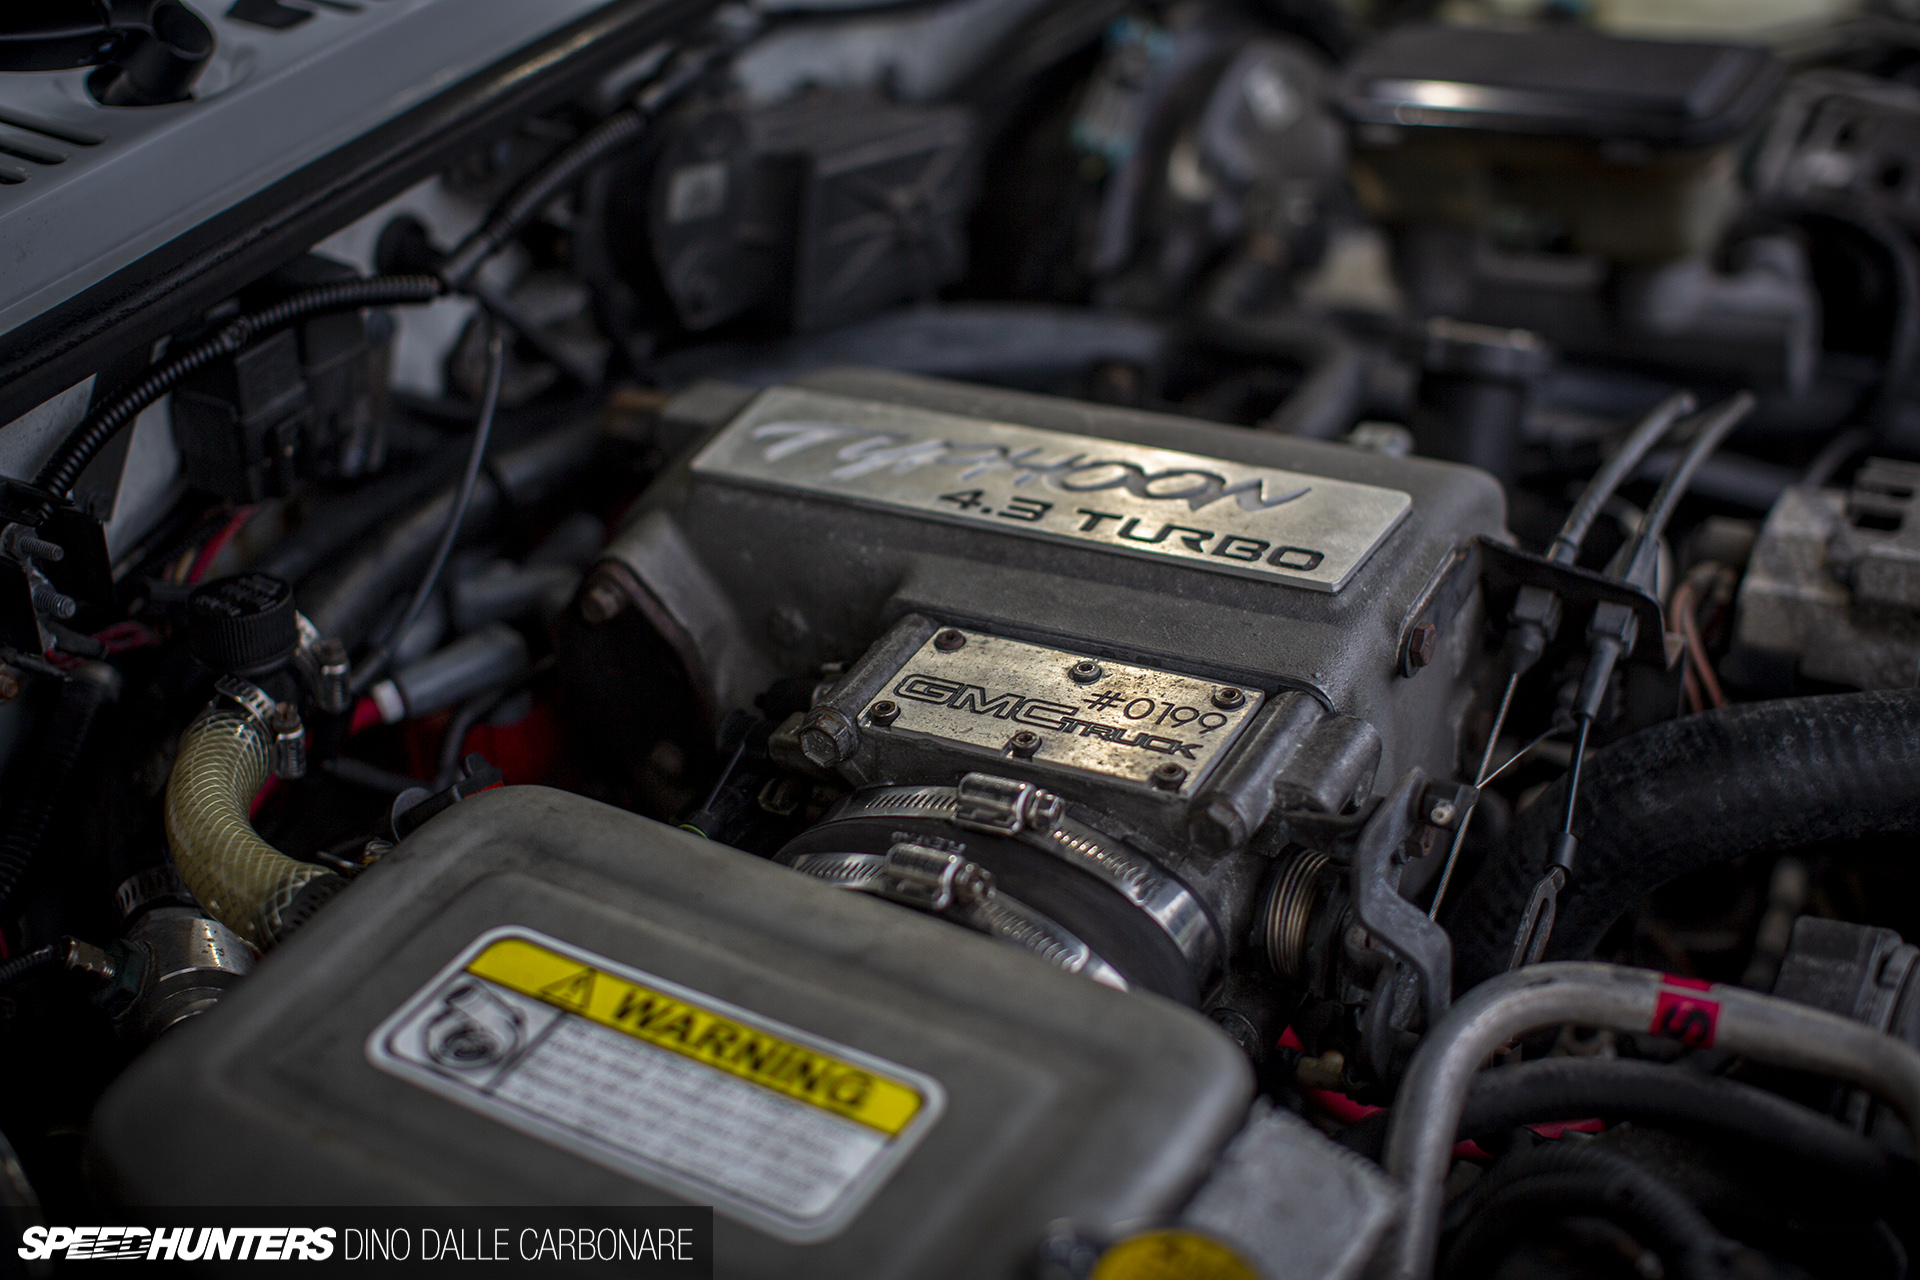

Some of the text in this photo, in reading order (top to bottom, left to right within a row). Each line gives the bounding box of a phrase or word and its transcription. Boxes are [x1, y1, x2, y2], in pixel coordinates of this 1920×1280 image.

[938, 488, 1325, 572] 4.3 TURBO
[893, 673, 1204, 760] GMC TRUCK
[1084, 690, 1228, 735] #0199
[612, 989, 875, 1109] WARNING
